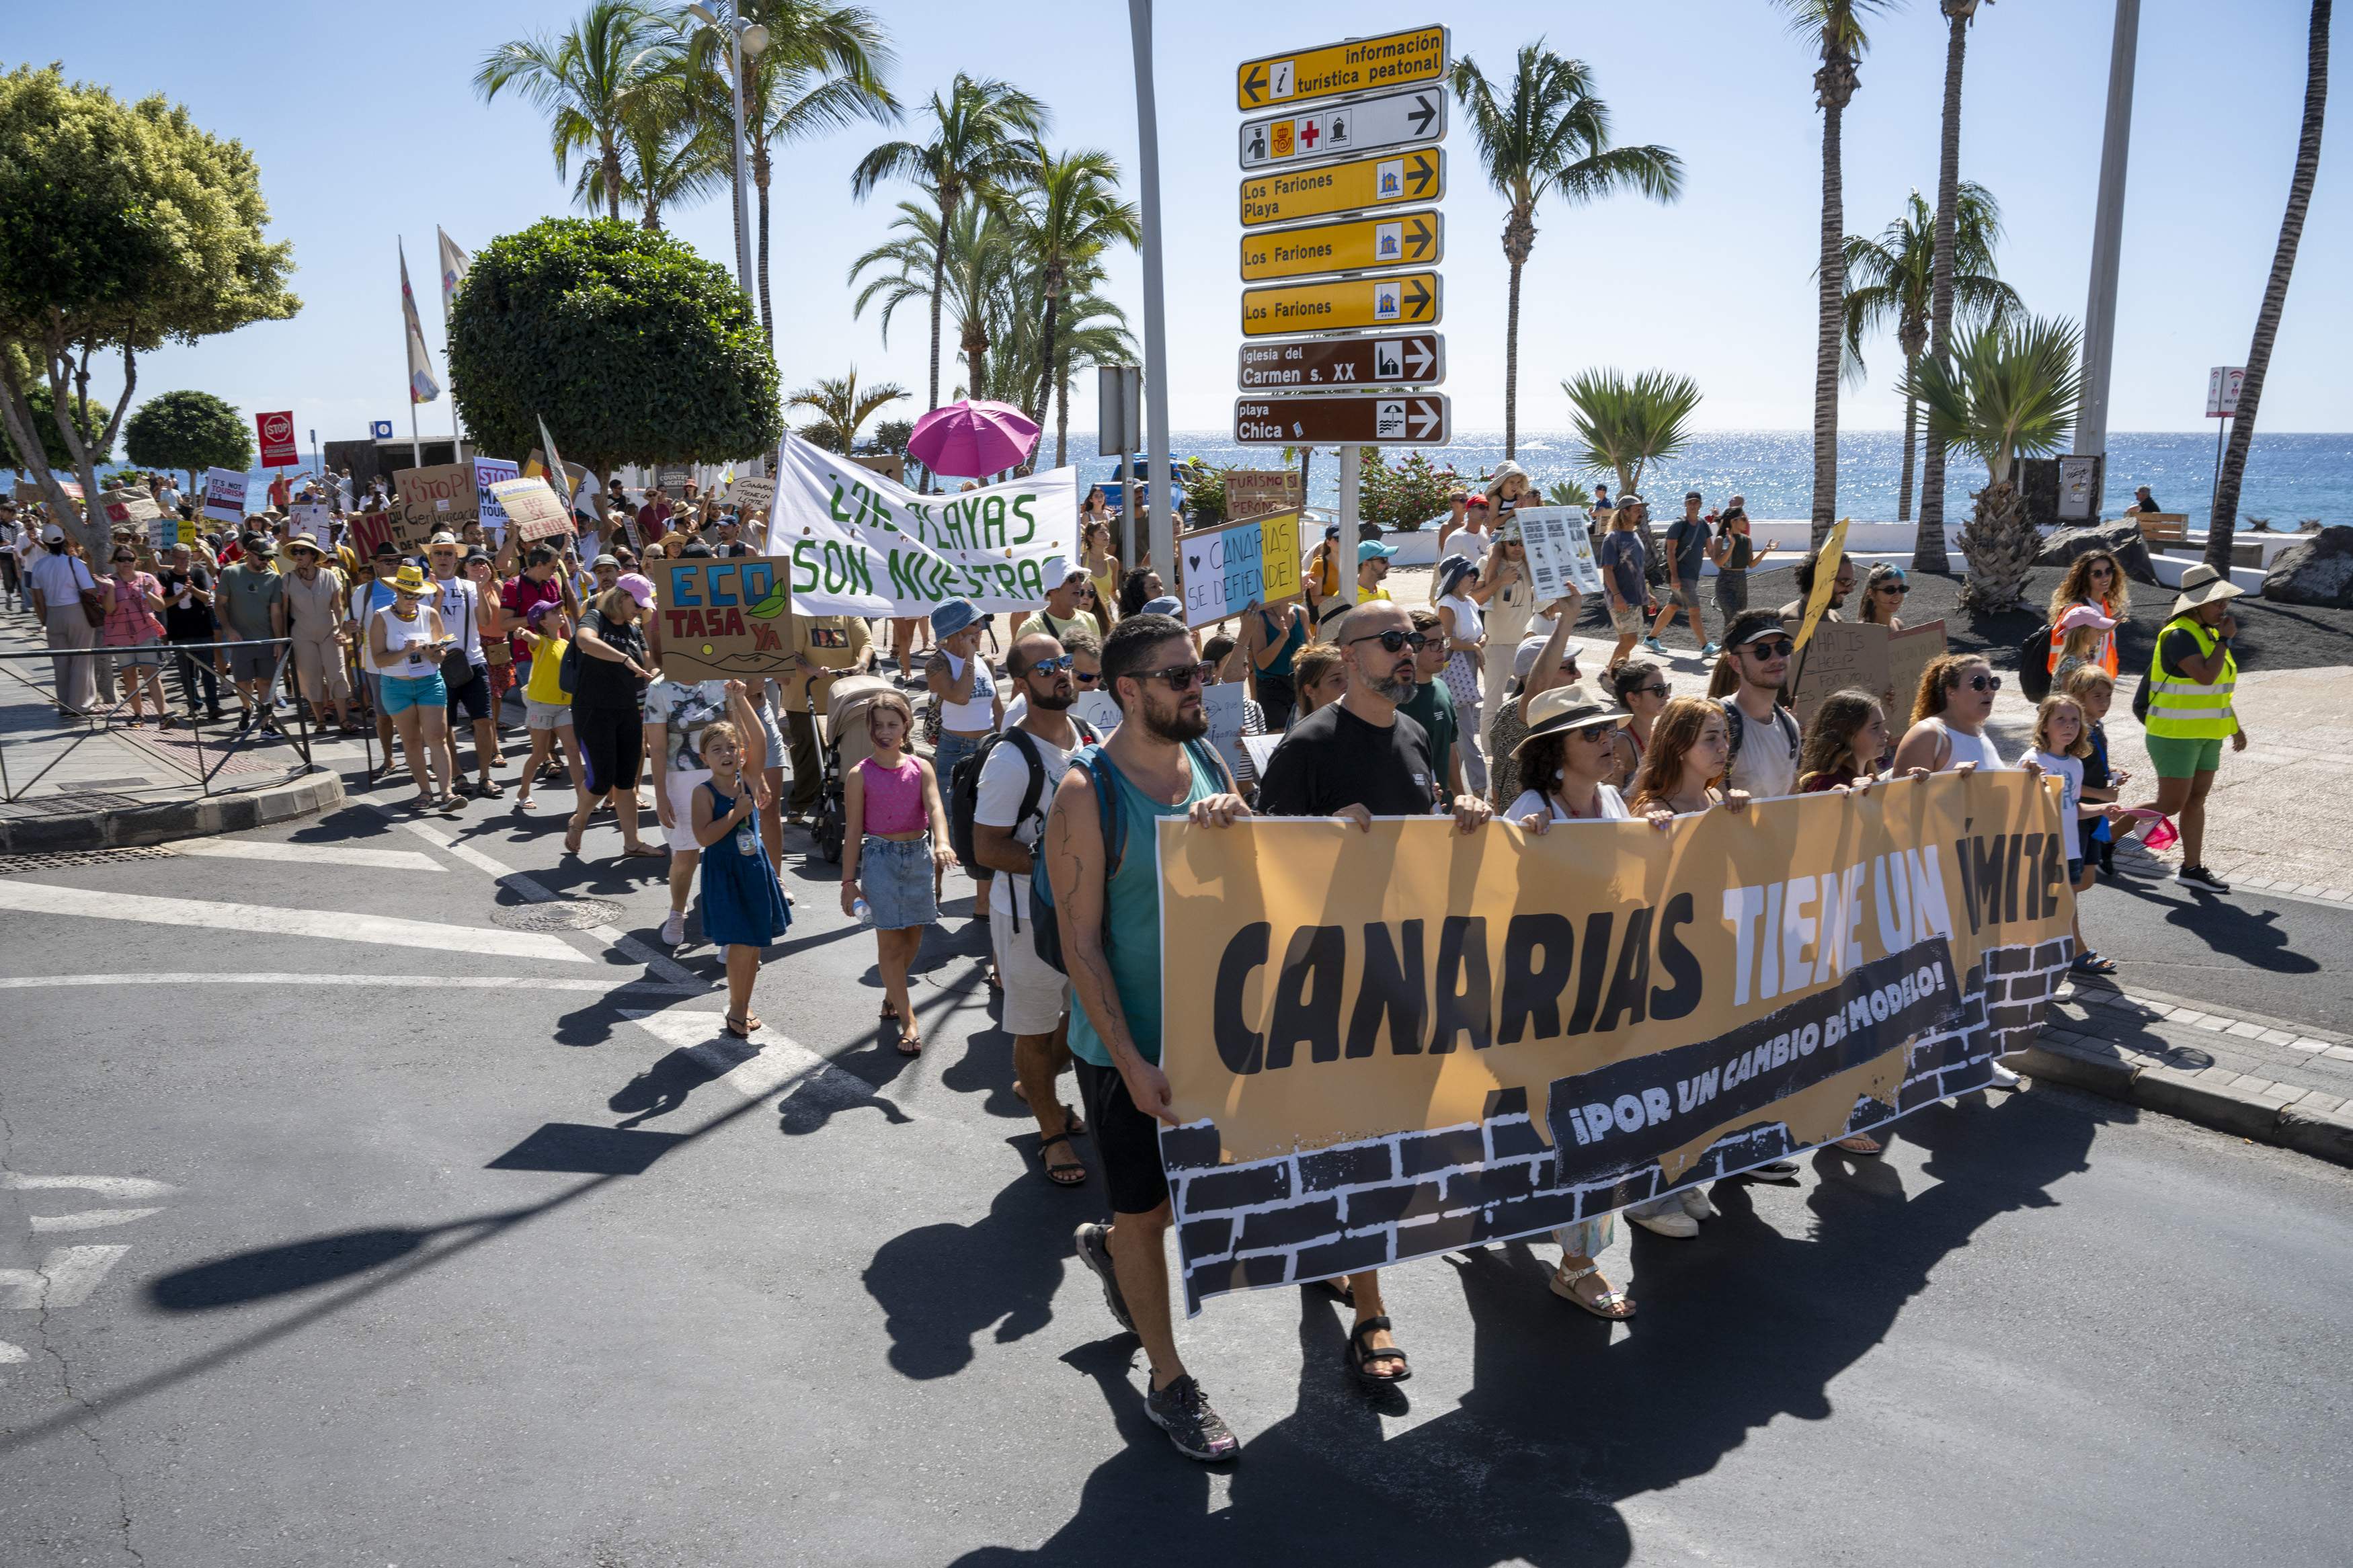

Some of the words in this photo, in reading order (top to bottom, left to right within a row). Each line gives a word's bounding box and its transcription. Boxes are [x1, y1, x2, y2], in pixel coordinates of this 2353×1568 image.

[1345, 33, 1439, 65] información
[1298, 70, 1359, 93] turística
[1369, 52, 1439, 83] peatonal
[1244, 185, 1267, 200] Los
[1275, 173, 1333, 196] Fariones
[1244, 201, 1279, 218] Playa
[1244, 251, 1267, 266] Los
[1275, 244, 1332, 262] Fariones
[1245, 304, 1267, 320] Los
[1275, 300, 1332, 318] Fariones
[1243, 348, 1279, 364] iglesia
[1285, 347, 1303, 360] del
[1242, 368, 1301, 384] Carmen
[1310, 368, 1323, 382] s.
[1332, 363, 1355, 381] XX
[1238, 403, 1269, 417] playa
[268, 423, 288, 434] STOP
[1238, 422, 1282, 439] Chica
[212, 479, 225, 487] IT'S
[229, 481, 243, 490] NOT
[403, 468, 469, 503] ¡STOP!
[479, 468, 516, 484] STOP
[1226, 474, 1283, 490] TURISMO
[212, 485, 245, 498] TOURISM
[737, 490, 760, 498] TIENE
[481, 505, 510, 518] TOUR
[1231, 500, 1261, 513] PERO
[524, 516, 567, 538] VENDE
[905, 493, 1037, 550] PLAYAS
[351, 513, 395, 565] NO
[1210, 523, 1291, 570] CANARIAS
[793, 539, 874, 596] SON
[670, 562, 773, 607] ECO
[1188, 585, 1208, 611] SE
[1213, 553, 1293, 606] DEFIENDE!
[666, 607, 746, 638] TASA
[750, 622, 783, 652] YA
[1845, 630, 1865, 651] IS
[1213, 893, 1704, 1075] CANARIAS
[1723, 862, 1868, 1007] TIENE
[1874, 844, 1954, 956] UN
[1568, 1087, 1673, 1147] ¡POR
[1677, 1066, 1720, 1114] UN
[1722, 1022, 1819, 1091] CAMBIO
[1823, 1006, 1847, 1048] DE
[1849, 961, 1946, 1033] MODELO!
